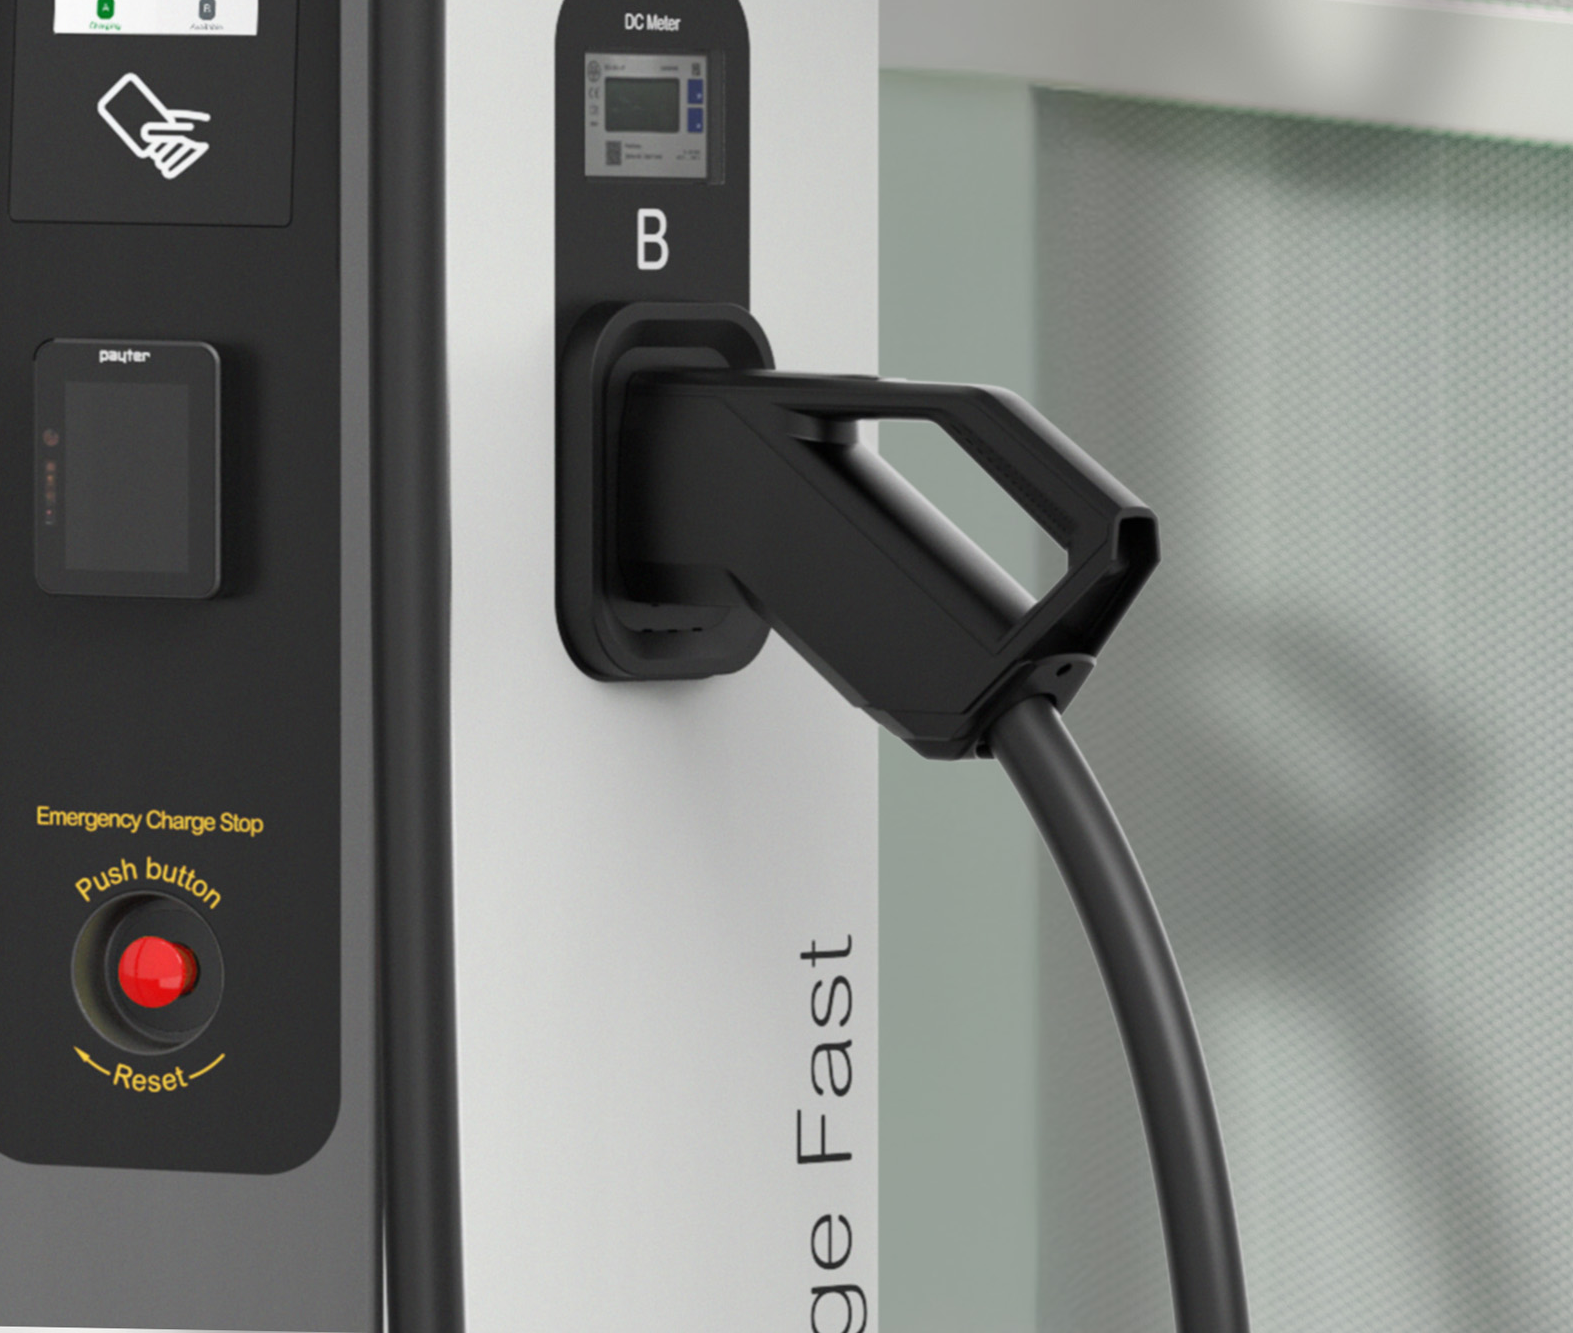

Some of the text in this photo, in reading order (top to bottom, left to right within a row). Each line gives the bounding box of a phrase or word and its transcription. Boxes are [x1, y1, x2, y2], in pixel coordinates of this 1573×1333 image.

[102, 3, 110, 12] A
[625, 13, 682, 32] DC Meter
[637, 208, 670, 271] B
[99, 348, 151, 364] payter
[36, 806, 264, 837] Emergency Charge Stop
[75, 856, 222, 910] Push button
[797, 934, 853, 1165] Fast
[113, 1063, 189, 1093] Reset
